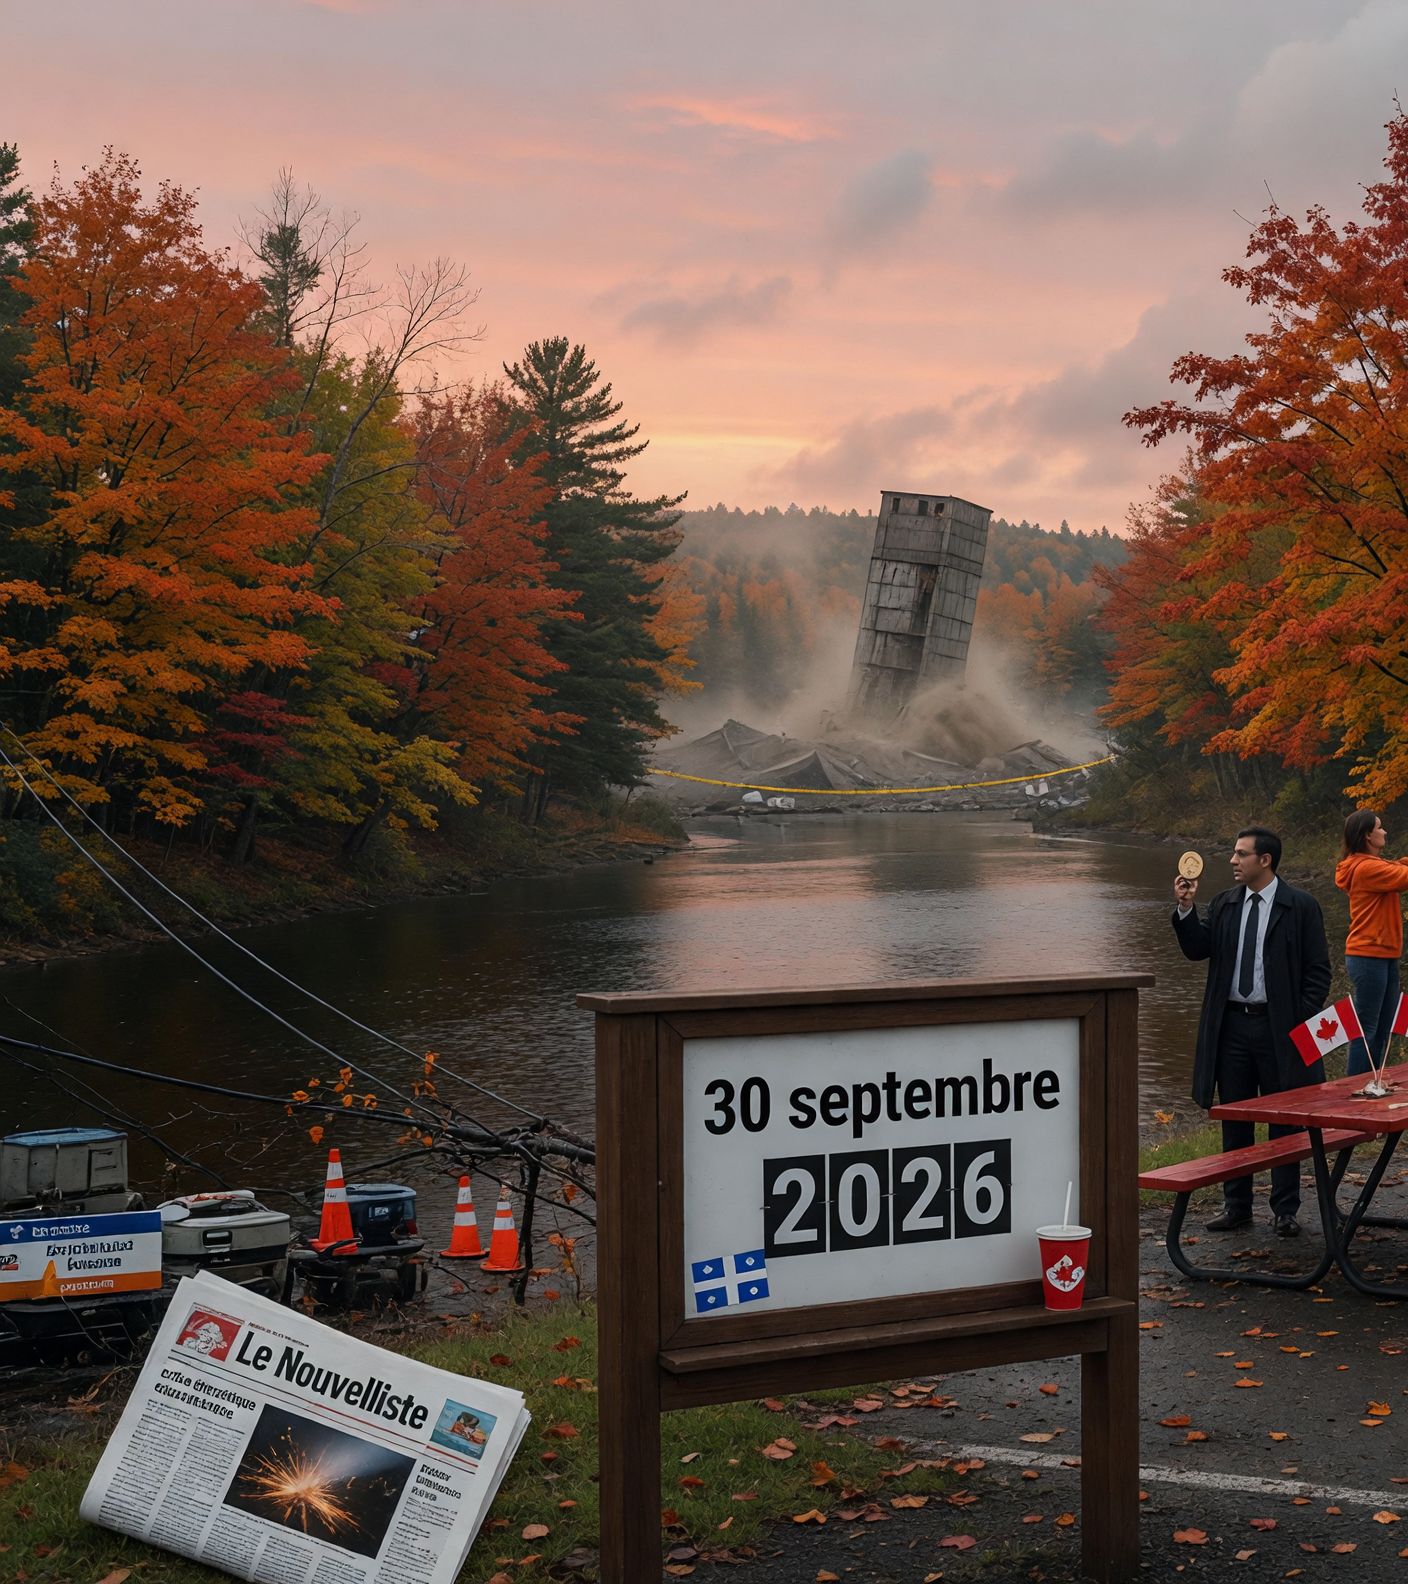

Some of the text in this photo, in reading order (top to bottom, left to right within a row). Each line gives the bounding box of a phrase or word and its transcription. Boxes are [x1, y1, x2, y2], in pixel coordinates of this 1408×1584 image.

[704, 1057, 1061, 1139] 30 septembre
[771, 1149, 1006, 1246] 2026
[235, 1330, 273, 1371] Le
[273, 1345, 429, 1430] Nouvelliste
